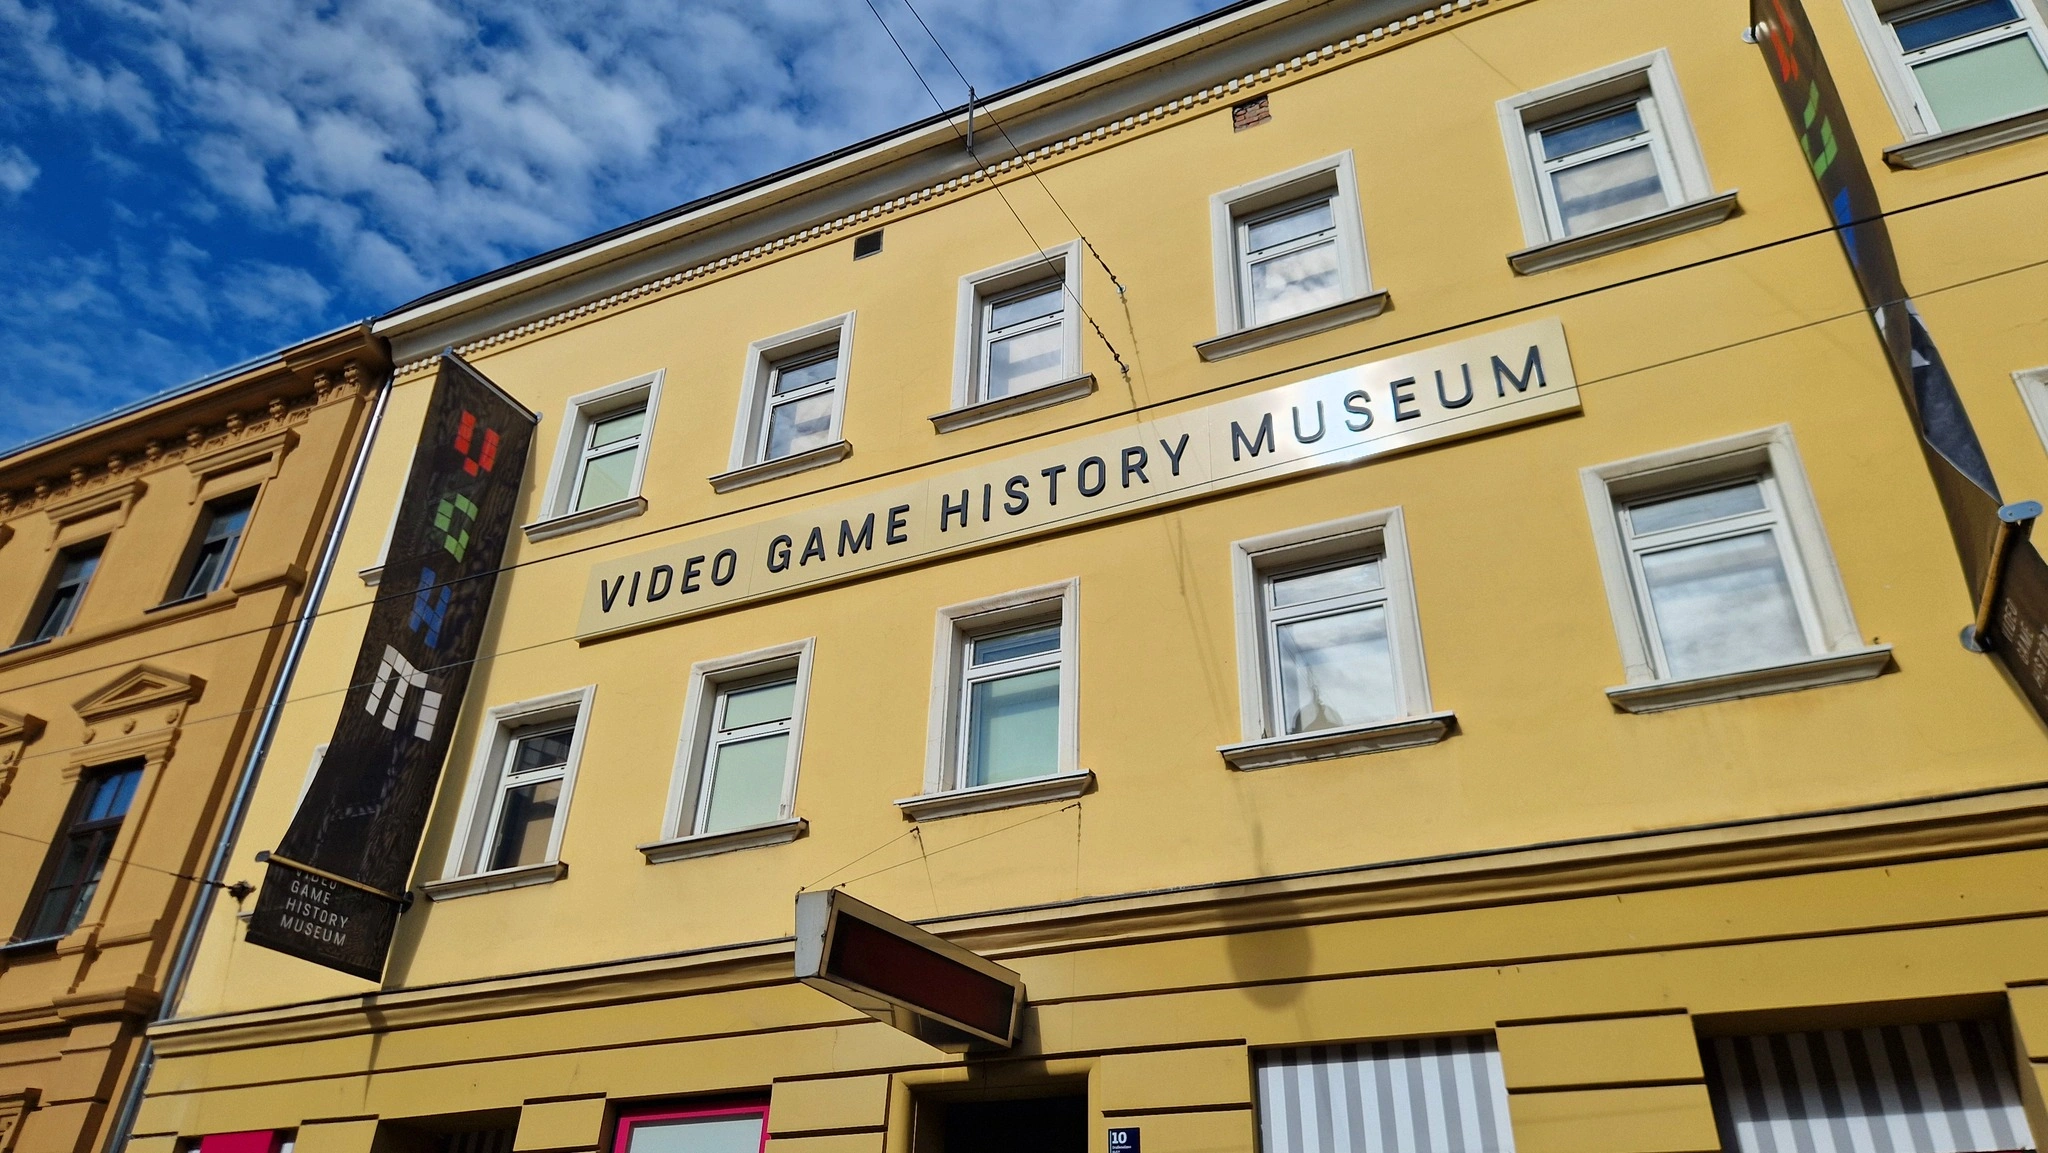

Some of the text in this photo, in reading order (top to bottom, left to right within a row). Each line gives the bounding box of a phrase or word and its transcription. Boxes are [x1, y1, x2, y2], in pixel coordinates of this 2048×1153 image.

[601, 345, 1547, 613] VIDEO GAME HISTORY MUSEUM
[291, 880, 331, 905] GAME
[286, 897, 348, 929] HISTORY
[280, 914, 346, 946] MUSEUM
[1112, 1131, 1127, 1144] 10
